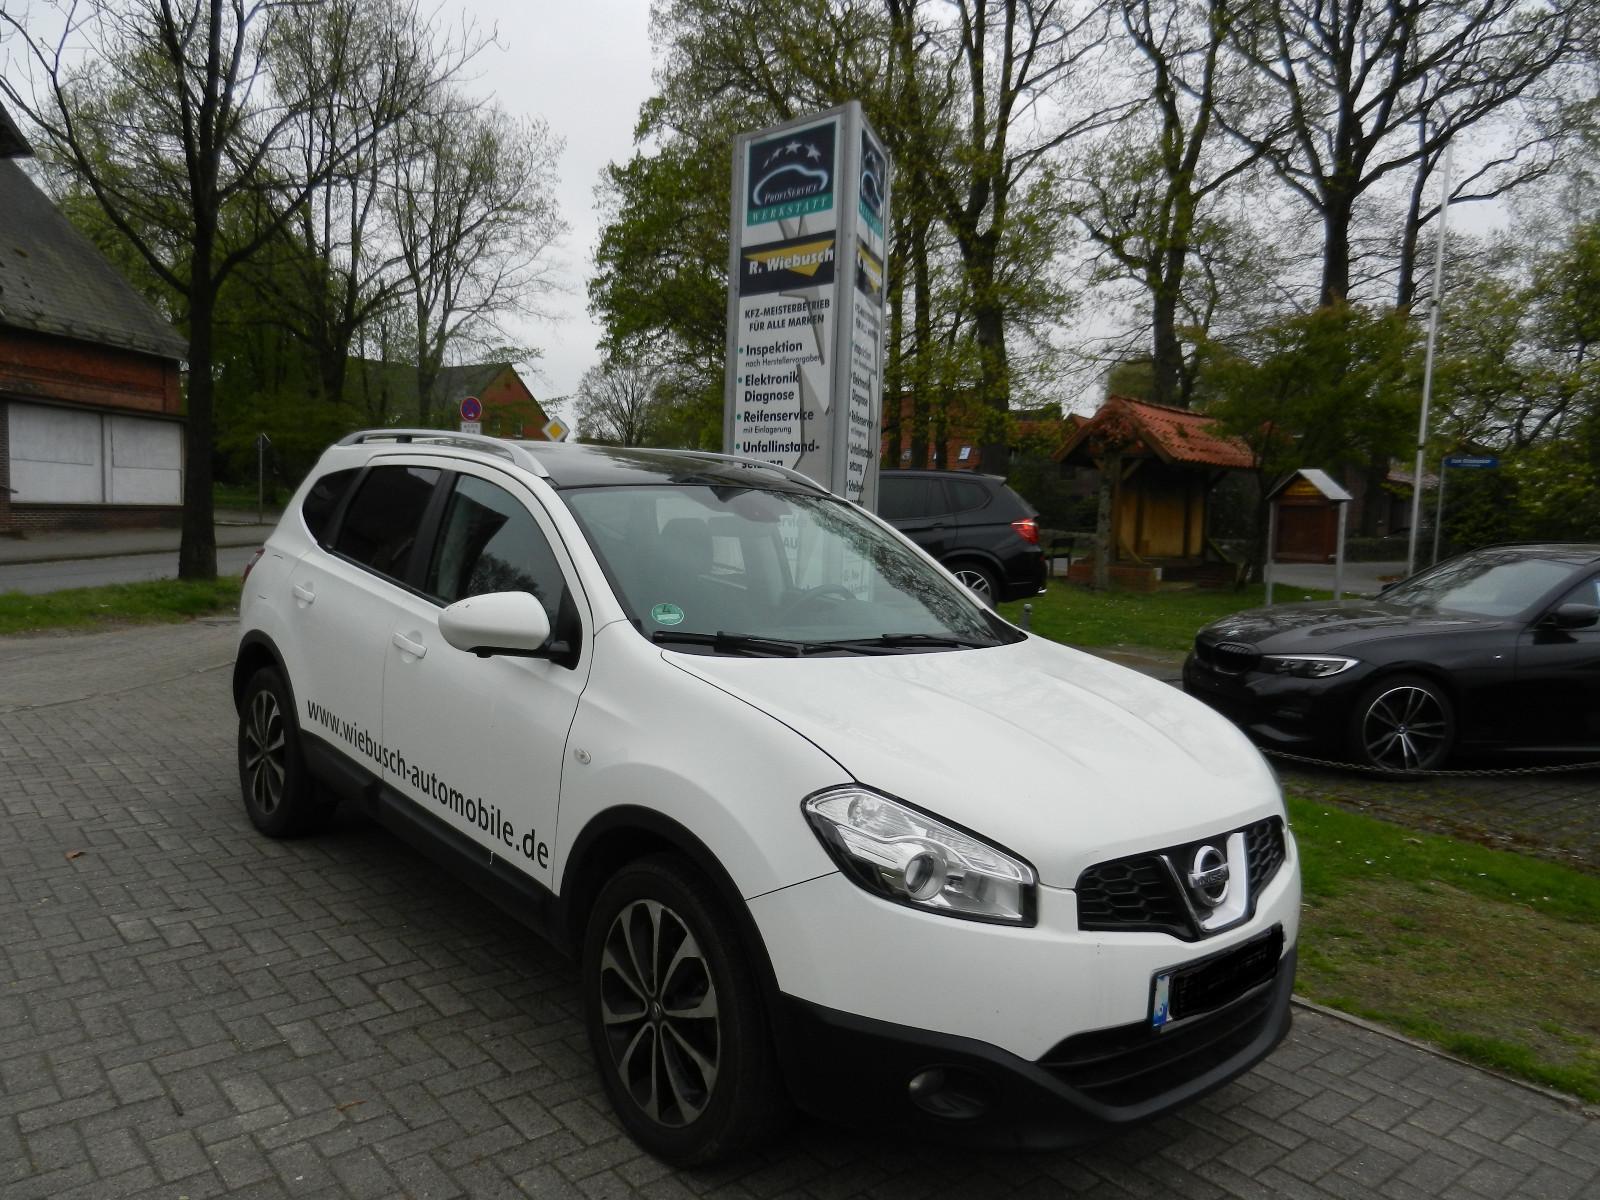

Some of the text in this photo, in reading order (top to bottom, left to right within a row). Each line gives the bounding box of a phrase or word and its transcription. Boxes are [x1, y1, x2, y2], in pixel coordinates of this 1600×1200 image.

[753, 197, 827, 222] WERKSTATT
[749, 249, 834, 275] R. Wiebusch
[745, 299, 830, 318] KFZ-MEISTERBETRIEB
[749, 314, 824, 332] FÜR ALLE MARKEN
[746, 341, 803, 357] Inspektion
[745, 360, 760, 368] nach
[745, 372, 799, 386] Elektronik
[744, 390, 794, 404] Diagnose
[743, 409, 814, 423] Reifenservice
[743, 425, 792, 435] mit Einlagerung
[743, 440, 820, 453] Unfallinstand-
[307, 700, 549, 870] www.wiebusch-automobile.de
